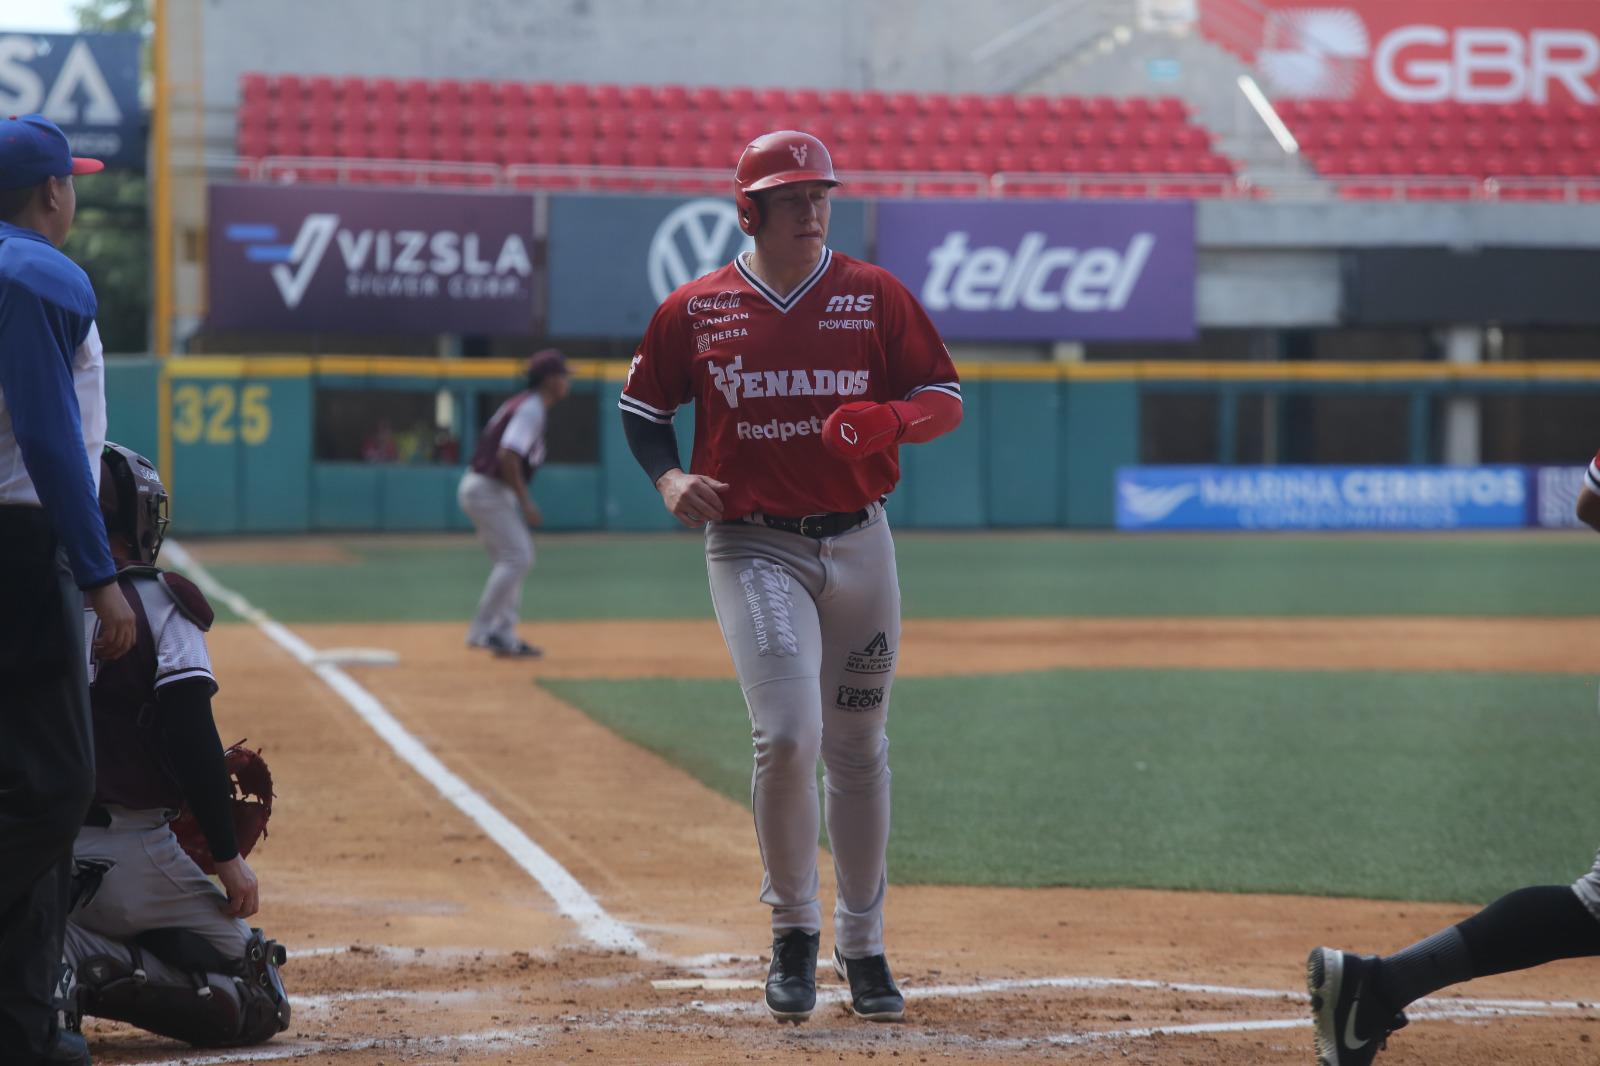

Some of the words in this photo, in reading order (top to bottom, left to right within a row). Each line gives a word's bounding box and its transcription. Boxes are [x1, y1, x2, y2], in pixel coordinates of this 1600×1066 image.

[1373, 24, 1600, 106] GBR
[337, 228, 533, 277] VIZSLA
[922, 230, 1157, 312] telcel
[692, 313, 749, 330] CHANGAN
[711, 327, 748, 342] HERSA
[174, 385, 271, 445] 325
[737, 416, 825, 441] Redpet
[1201, 472, 1341, 507] MARINA
[1342, 469, 1525, 507] CERRITOS
[846, 661, 891, 670] MEXICANA
